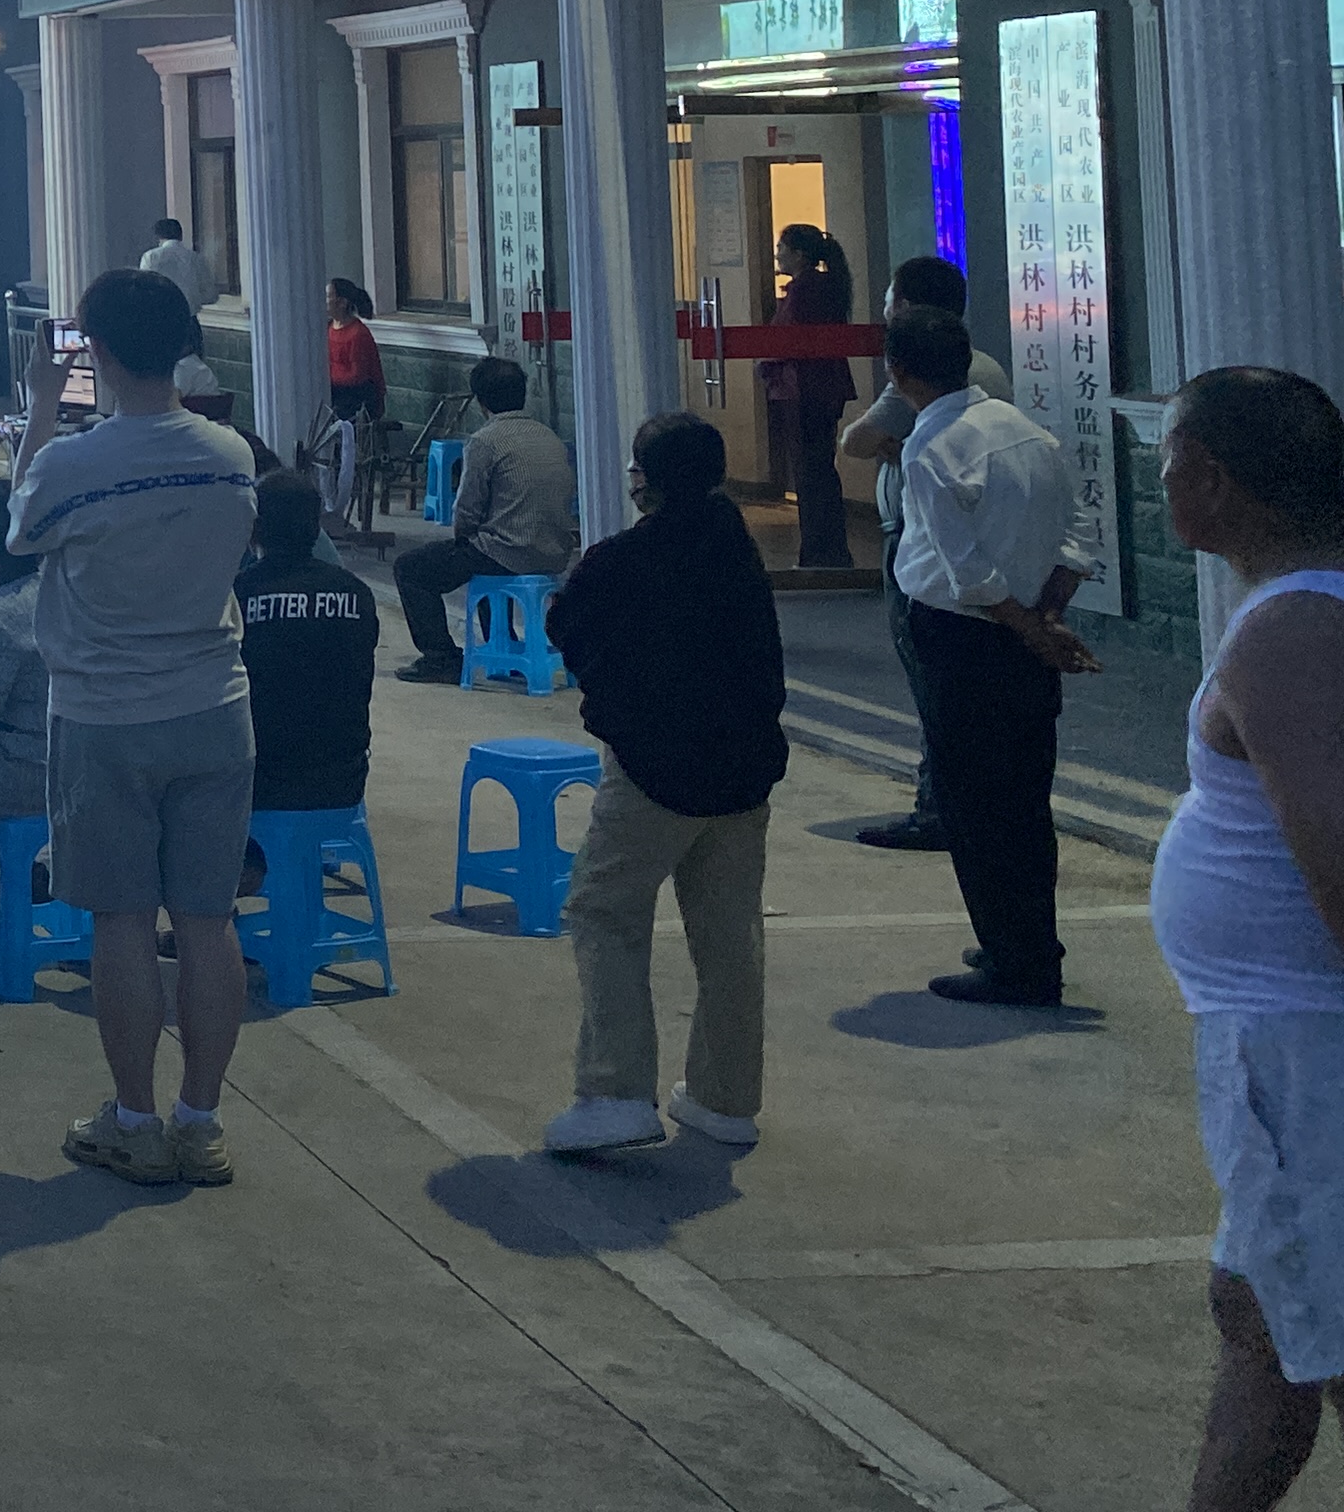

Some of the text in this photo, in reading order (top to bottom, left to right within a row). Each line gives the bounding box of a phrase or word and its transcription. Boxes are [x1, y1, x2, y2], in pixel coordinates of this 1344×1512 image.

[1027, 44, 1046, 203] 中国共产党
[1056, 41, 1074, 203] 产业园区
[1075, 40, 1096, 204] 滨海现代农业
[246, 593, 309, 624] BETTER
